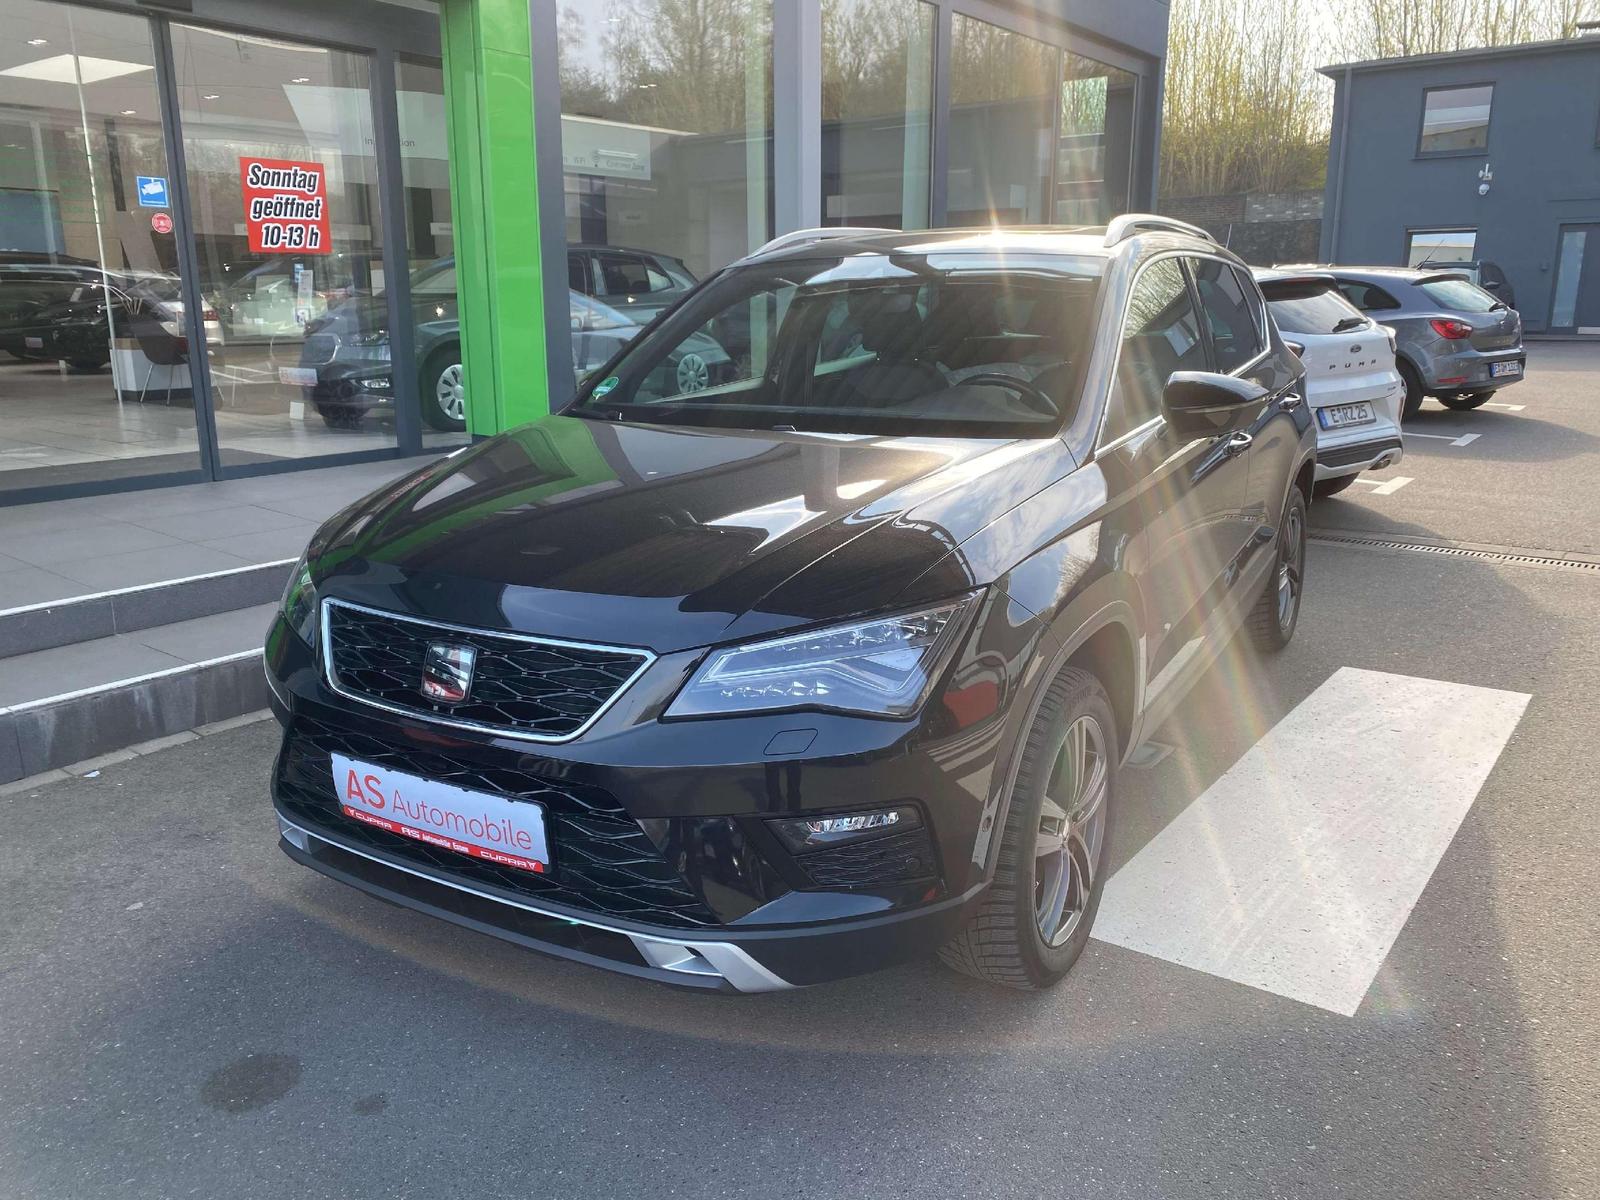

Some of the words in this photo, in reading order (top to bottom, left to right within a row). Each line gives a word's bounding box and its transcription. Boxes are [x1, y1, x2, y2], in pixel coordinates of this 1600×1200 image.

[248, 163, 319, 194] Sonntag
[251, 195, 321, 220] geöffnet
[262, 224, 304, 247] 10-13
[307, 225, 320, 248] h
[346, 769, 385, 809] AS
[393, 789, 531, 850] Automobile
[355, 813, 393, 830] CUPRA
[480, 850, 528, 867] CUPRA
